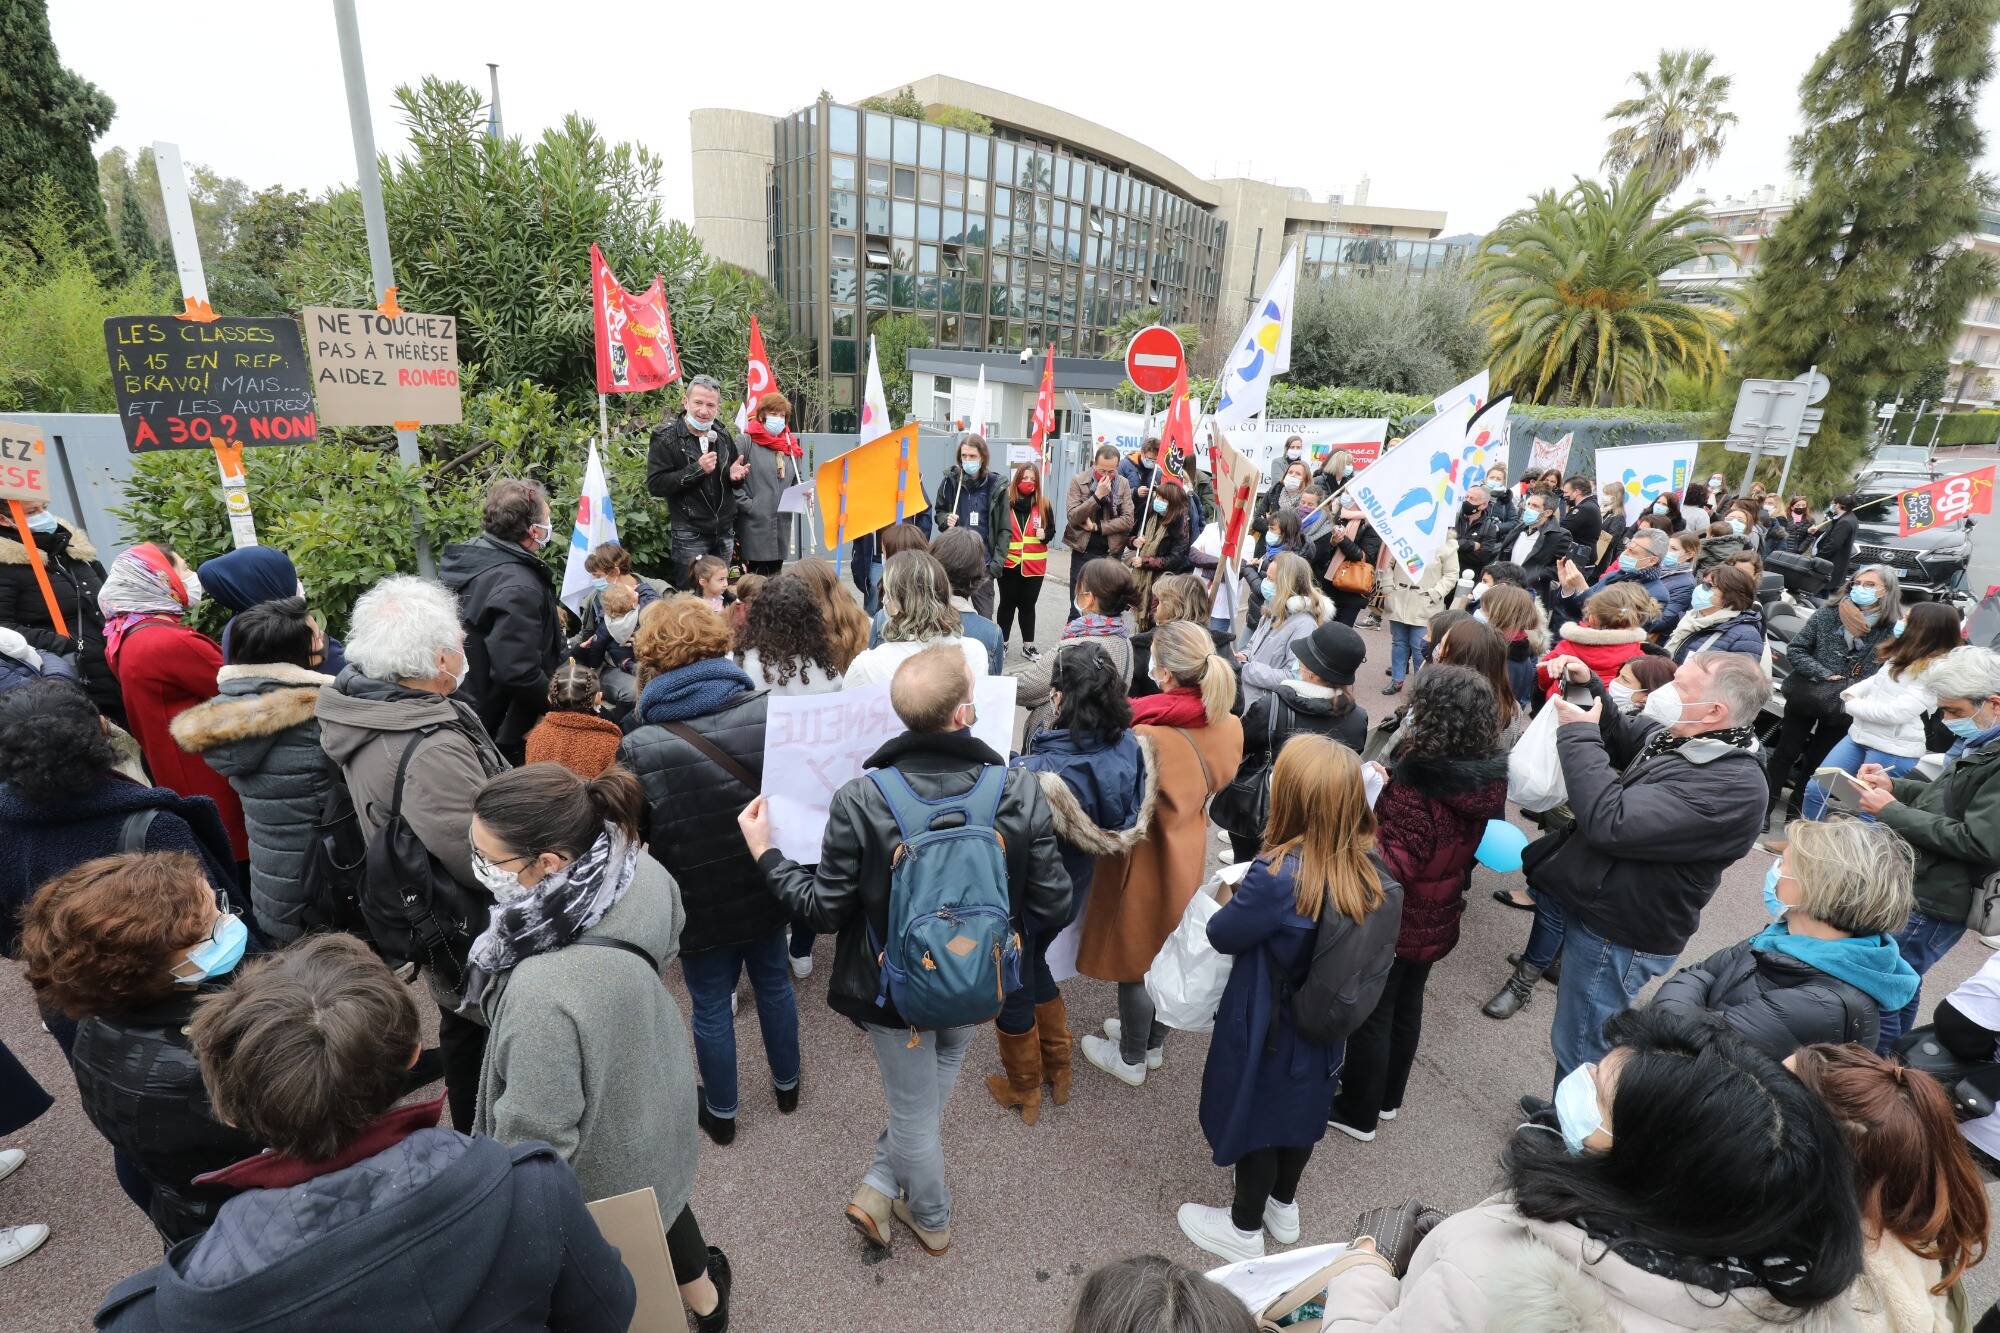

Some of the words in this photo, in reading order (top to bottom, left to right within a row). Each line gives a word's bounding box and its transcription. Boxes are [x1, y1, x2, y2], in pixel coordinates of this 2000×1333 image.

[118, 324, 167, 344] LES
[180, 325, 275, 343] CLASSES
[317, 313, 351, 335] NE
[358, 314, 454, 339] TOUCHEZ
[143, 353, 169, 369] 15
[186, 350, 218, 369] EN
[318, 341, 356, 358] PAS
[364, 340, 377, 360] À
[383, 340, 449, 362] THÉRÈSE
[125, 371, 209, 395] BRAVO!
[319, 367, 387, 386] AIDEZ
[397, 368, 458, 387] ROMEO
[128, 400, 164, 417] ET
[178, 399, 222, 416] LES
[134, 415, 161, 447] À
[167, 416, 213, 443] 30
[0, 437, 32, 462] EZ
[1936, 477, 1971, 520] cgt
[1907, 497, 1919, 528] ACTION
